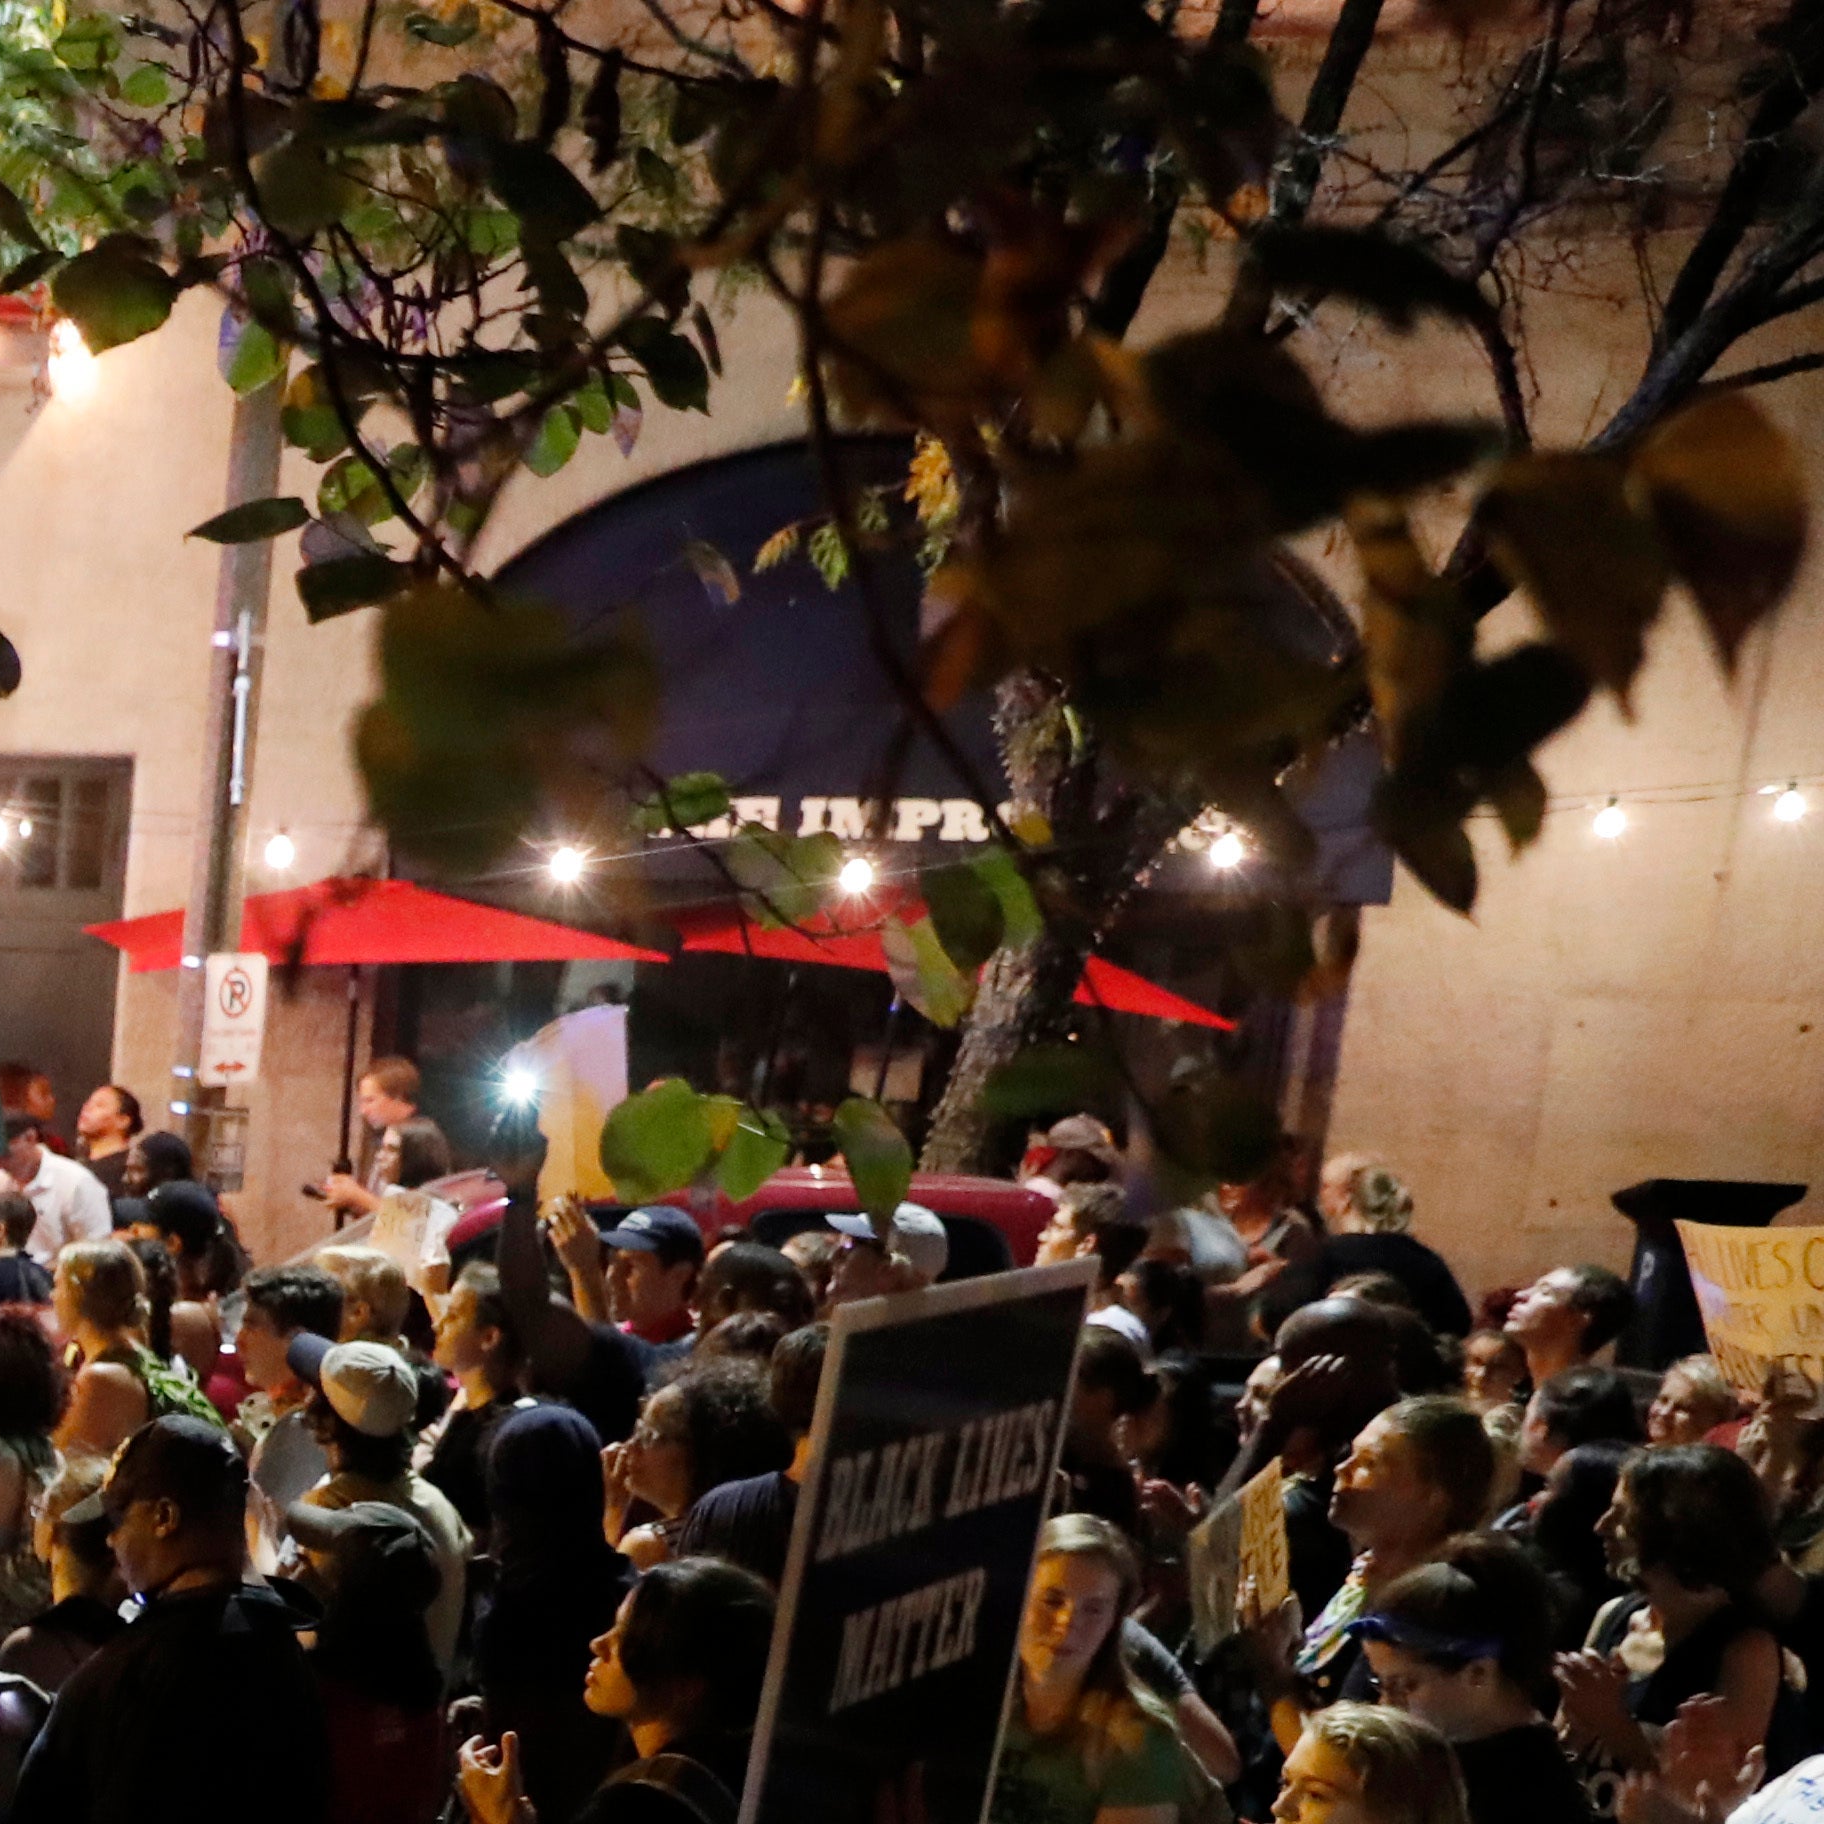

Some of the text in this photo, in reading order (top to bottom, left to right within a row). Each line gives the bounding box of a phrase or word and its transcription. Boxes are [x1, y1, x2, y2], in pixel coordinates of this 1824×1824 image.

[797, 796, 1012, 842] IMPR
[815, 1399, 1055, 1562] BLACK LIVES
[829, 1566, 986, 1715] MATTER
